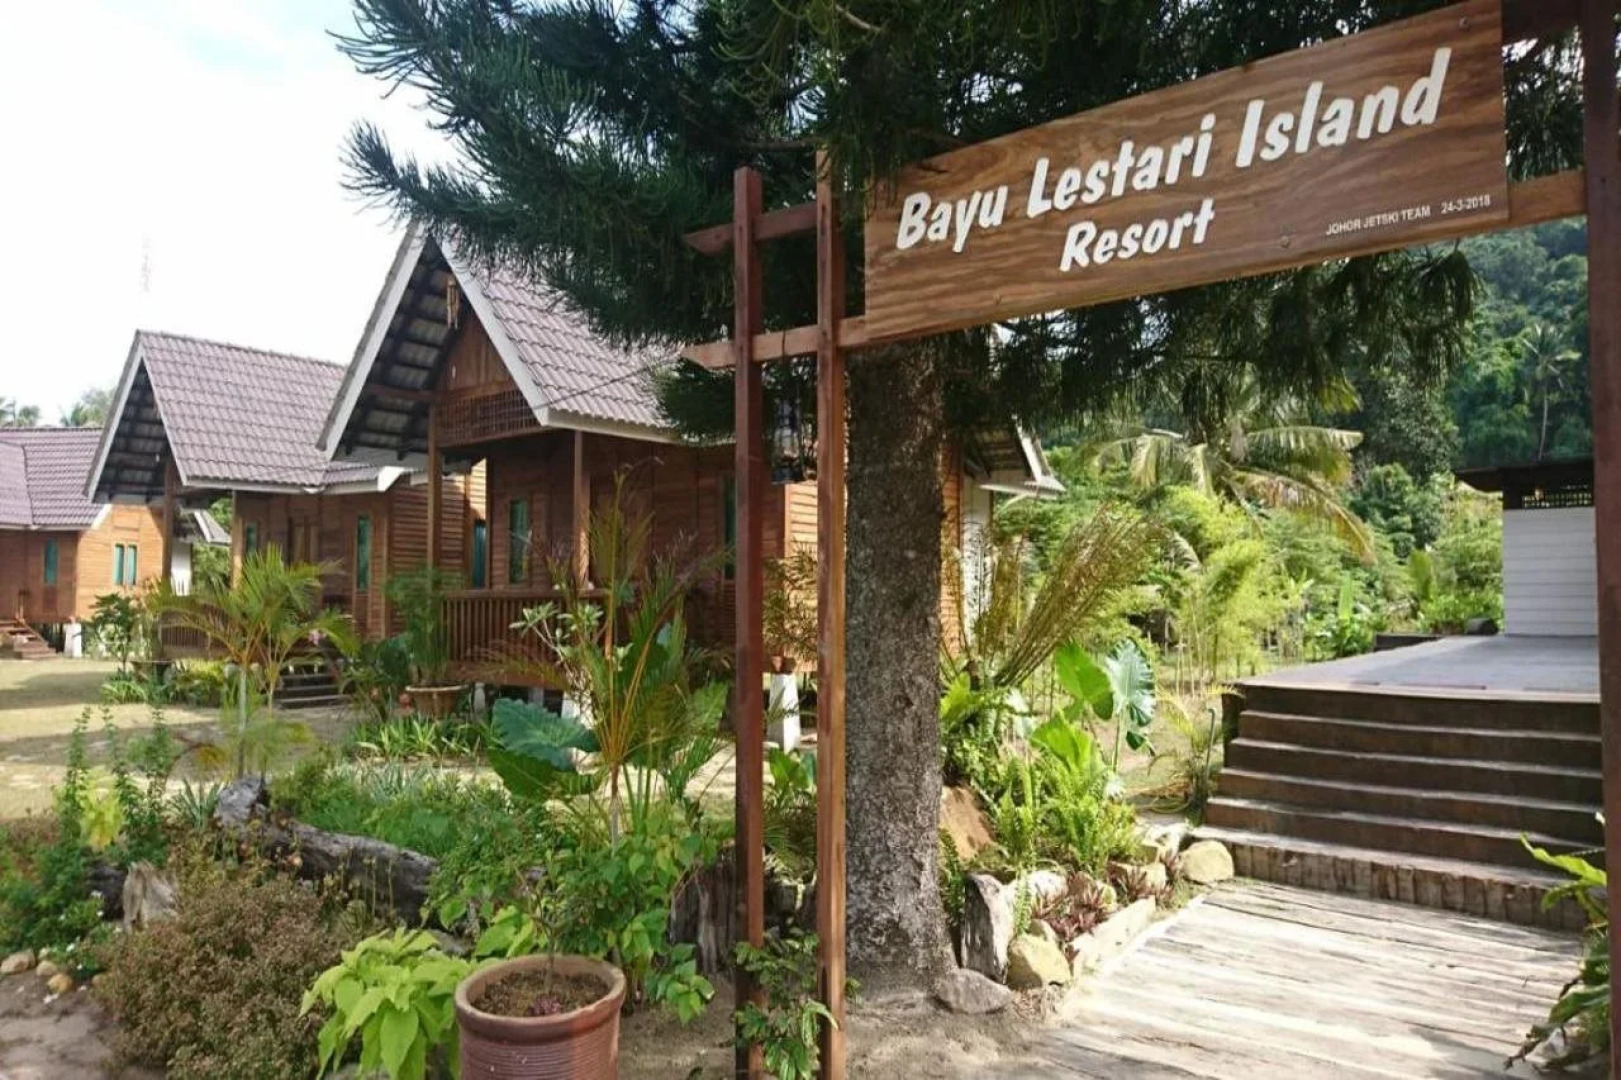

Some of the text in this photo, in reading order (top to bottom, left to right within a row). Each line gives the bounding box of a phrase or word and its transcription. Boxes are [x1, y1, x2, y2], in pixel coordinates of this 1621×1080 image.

[896, 47, 1452, 253] Bayu Lestari Island
[1059, 198, 1216, 272] Resort
[1326, 218, 1361, 235] JOHOR
[1363, 210, 1399, 228] JETSKI
[1400, 205, 1431, 221] TEAM
